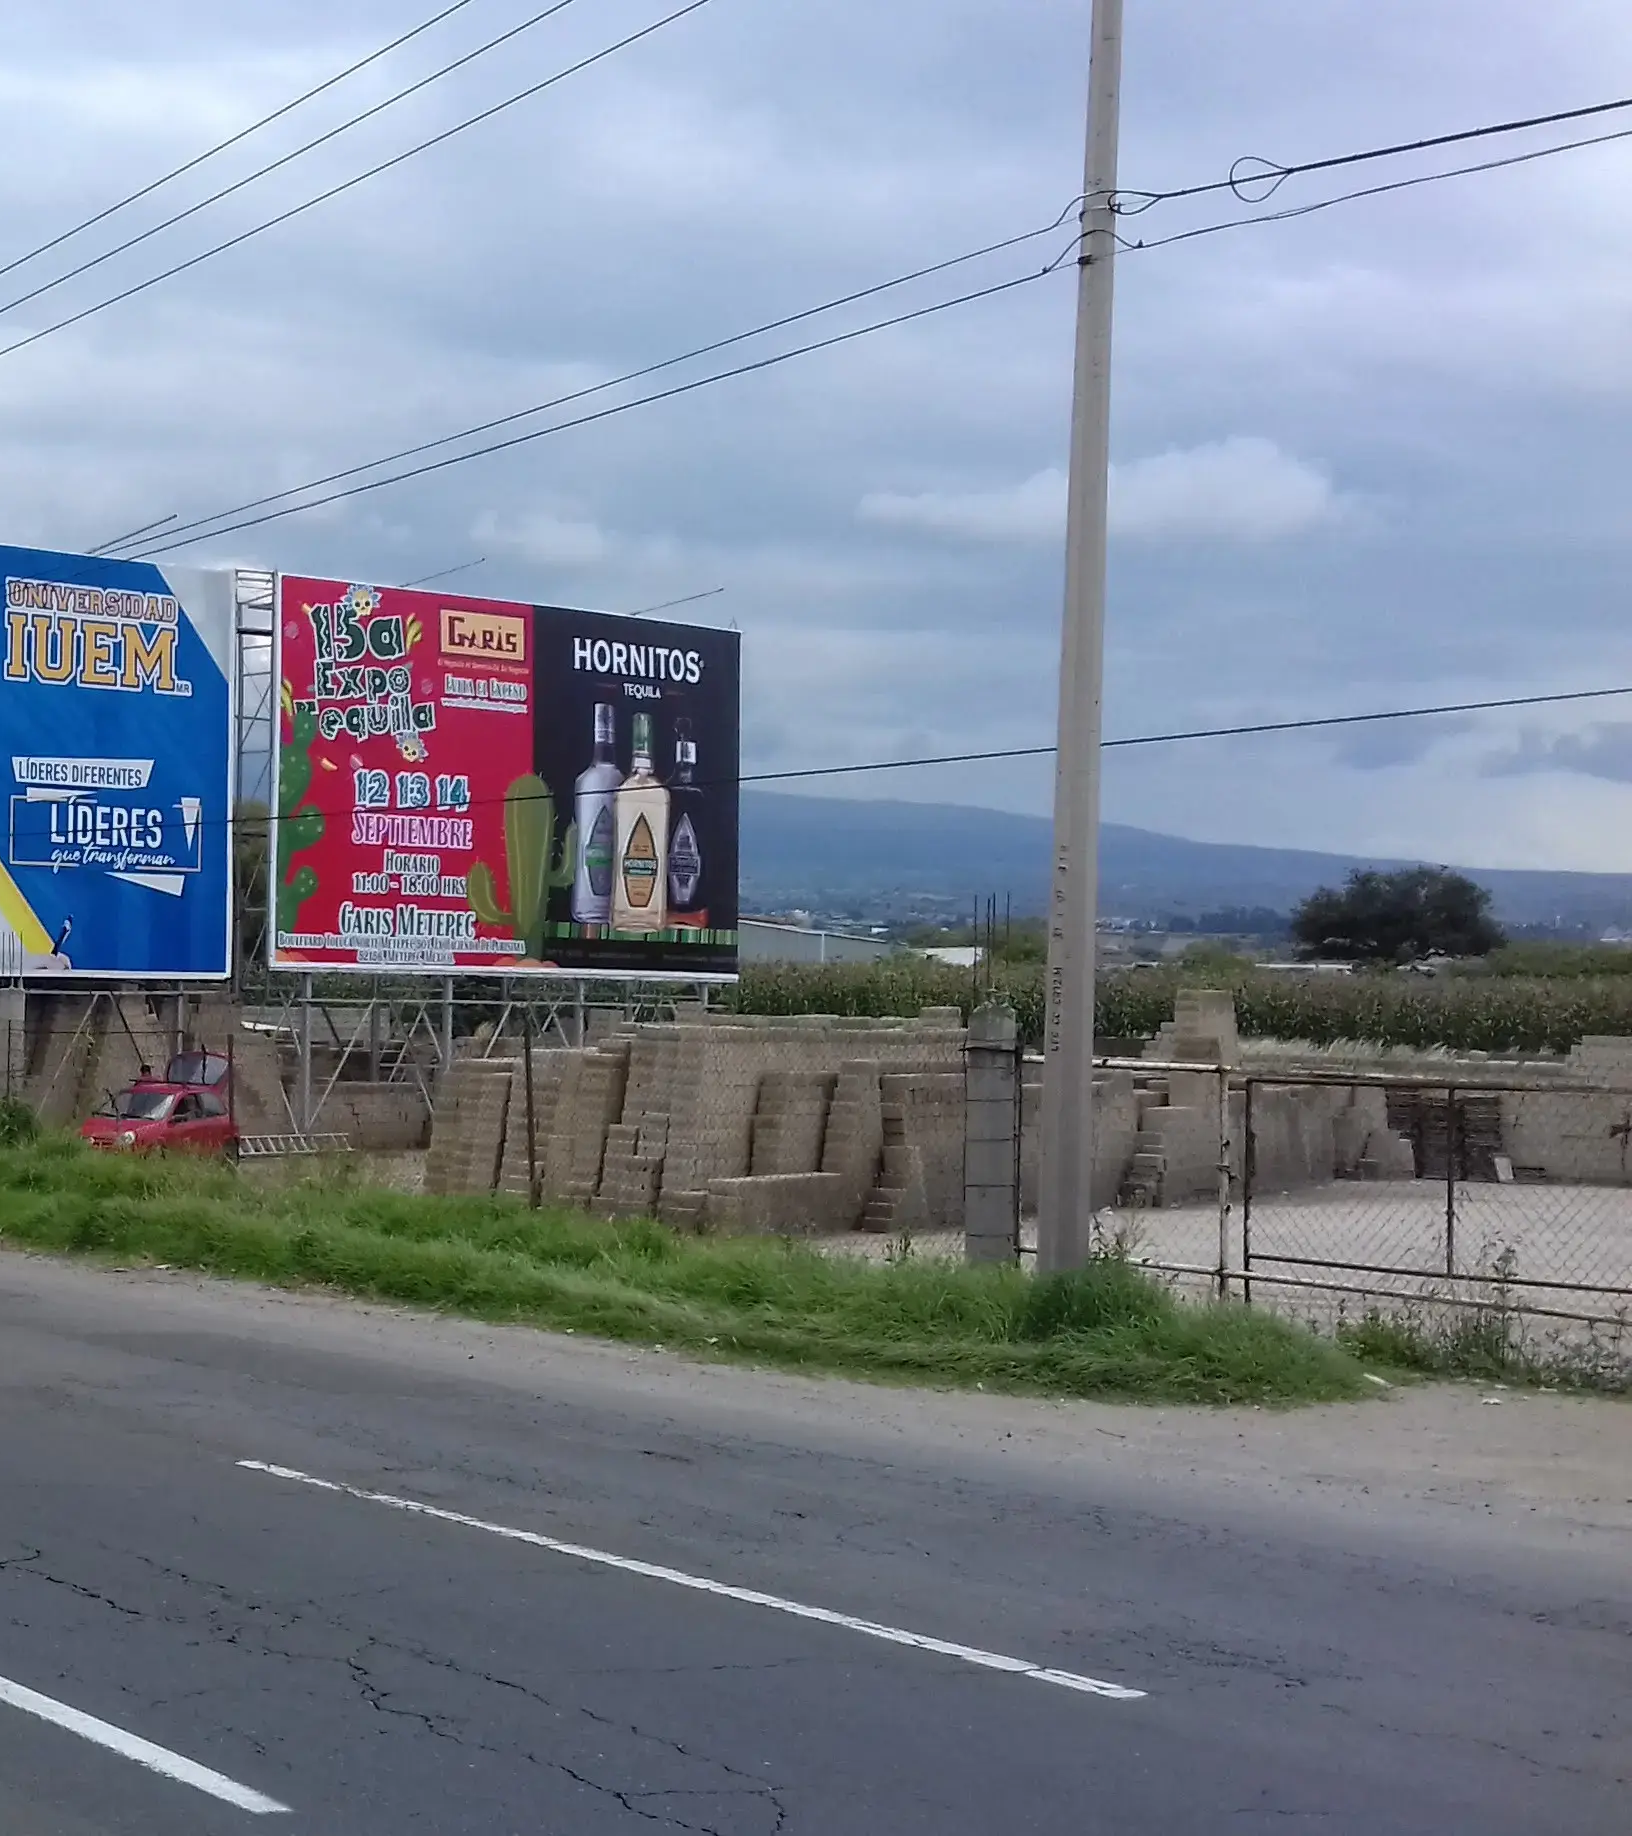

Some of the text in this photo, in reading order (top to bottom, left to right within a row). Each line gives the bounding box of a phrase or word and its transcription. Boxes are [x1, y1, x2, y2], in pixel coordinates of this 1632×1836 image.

[7, 579, 179, 624] UNIVERSIDAD
[5, 610, 178, 692] IUEM
[573, 637, 700, 684] HORNITOS
[315, 660, 411, 702] Expo
[622, 682, 662, 700] TEQUILA
[18, 757, 142, 787] LÍDERES DIFERENTES
[354, 769, 471, 812] 12 13 14
[51, 796, 163, 848] LÍDERES
[352, 807, 473, 849] SEPTIEMBRE
[51, 842, 176, 874] que transforman
[384, 849, 441, 875] HORARIO
[353, 872, 388, 894] 11:00
[401, 874, 439, 897] 18:00
